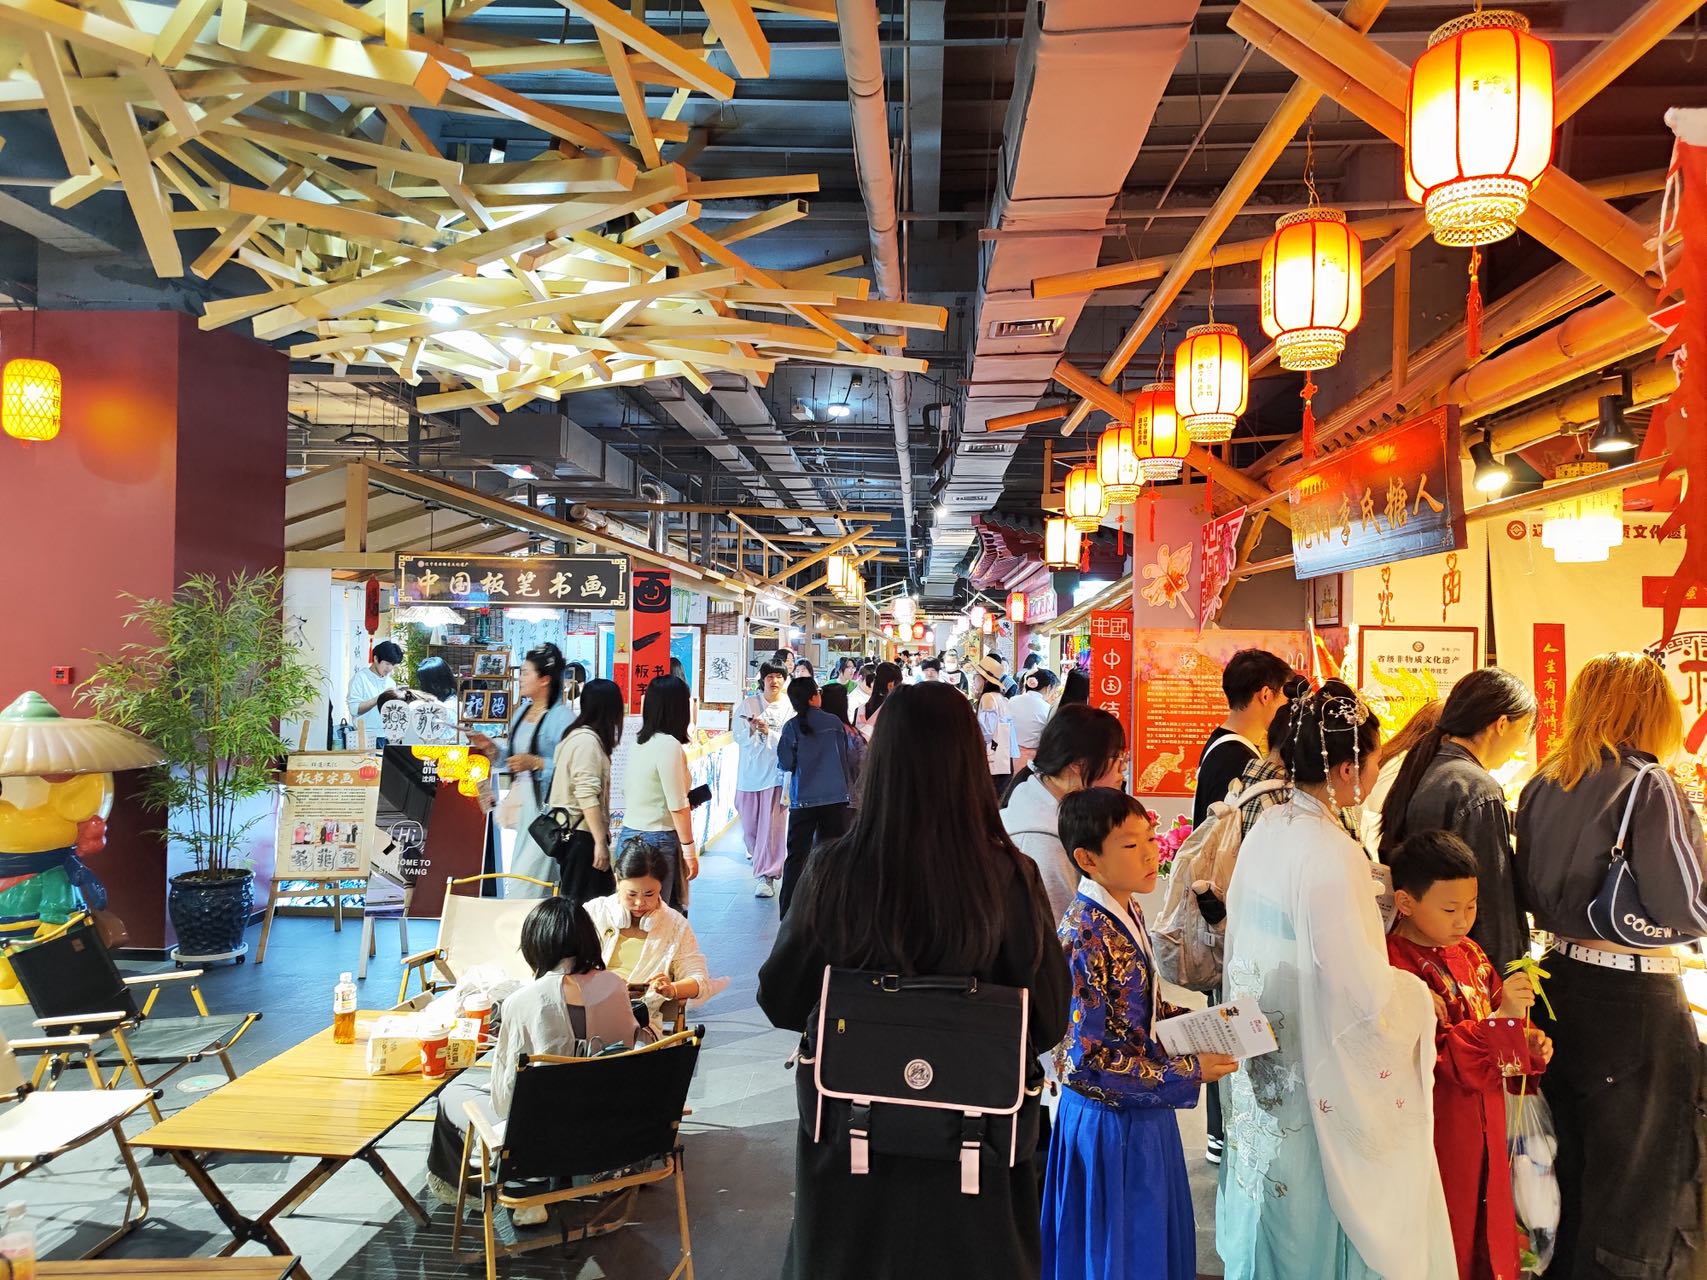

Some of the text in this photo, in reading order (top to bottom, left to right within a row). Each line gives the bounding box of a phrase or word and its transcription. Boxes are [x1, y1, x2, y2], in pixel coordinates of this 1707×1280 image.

[1377, 655, 1460, 664] 省级非物质文化遗产
[398, 827, 417, 842] Hi
[420, 859, 431, 867] TO
[404, 868, 427, 876] YANG
